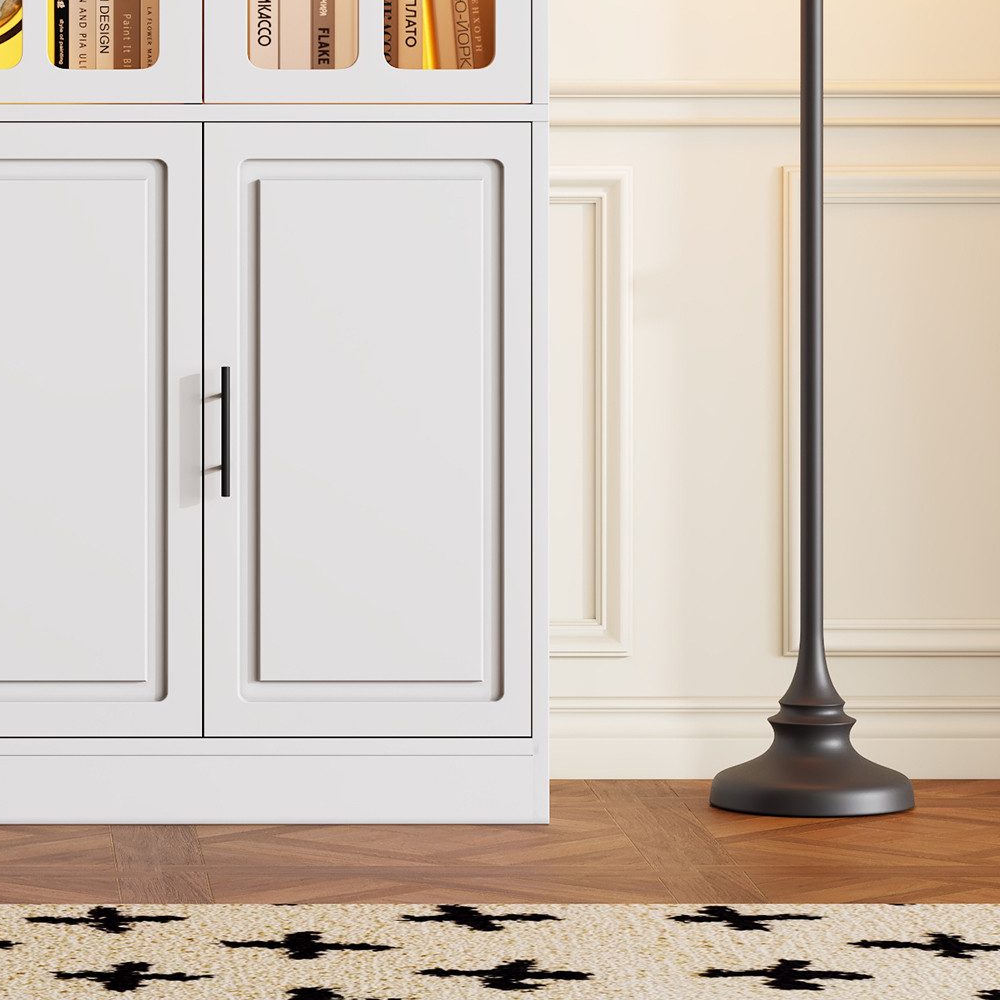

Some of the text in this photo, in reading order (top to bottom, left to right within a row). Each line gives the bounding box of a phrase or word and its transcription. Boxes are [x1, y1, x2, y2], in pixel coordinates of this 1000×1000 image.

[79, 8, 87, 28] AND
[147, 7, 152, 15] LA
[100, 6, 109, 53] DESIGN
[123, 14, 131, 40] Paint
[79, 33, 87, 48] PIA
[123, 45, 131, 53] It
[318, 28, 329, 65] FLAKE
